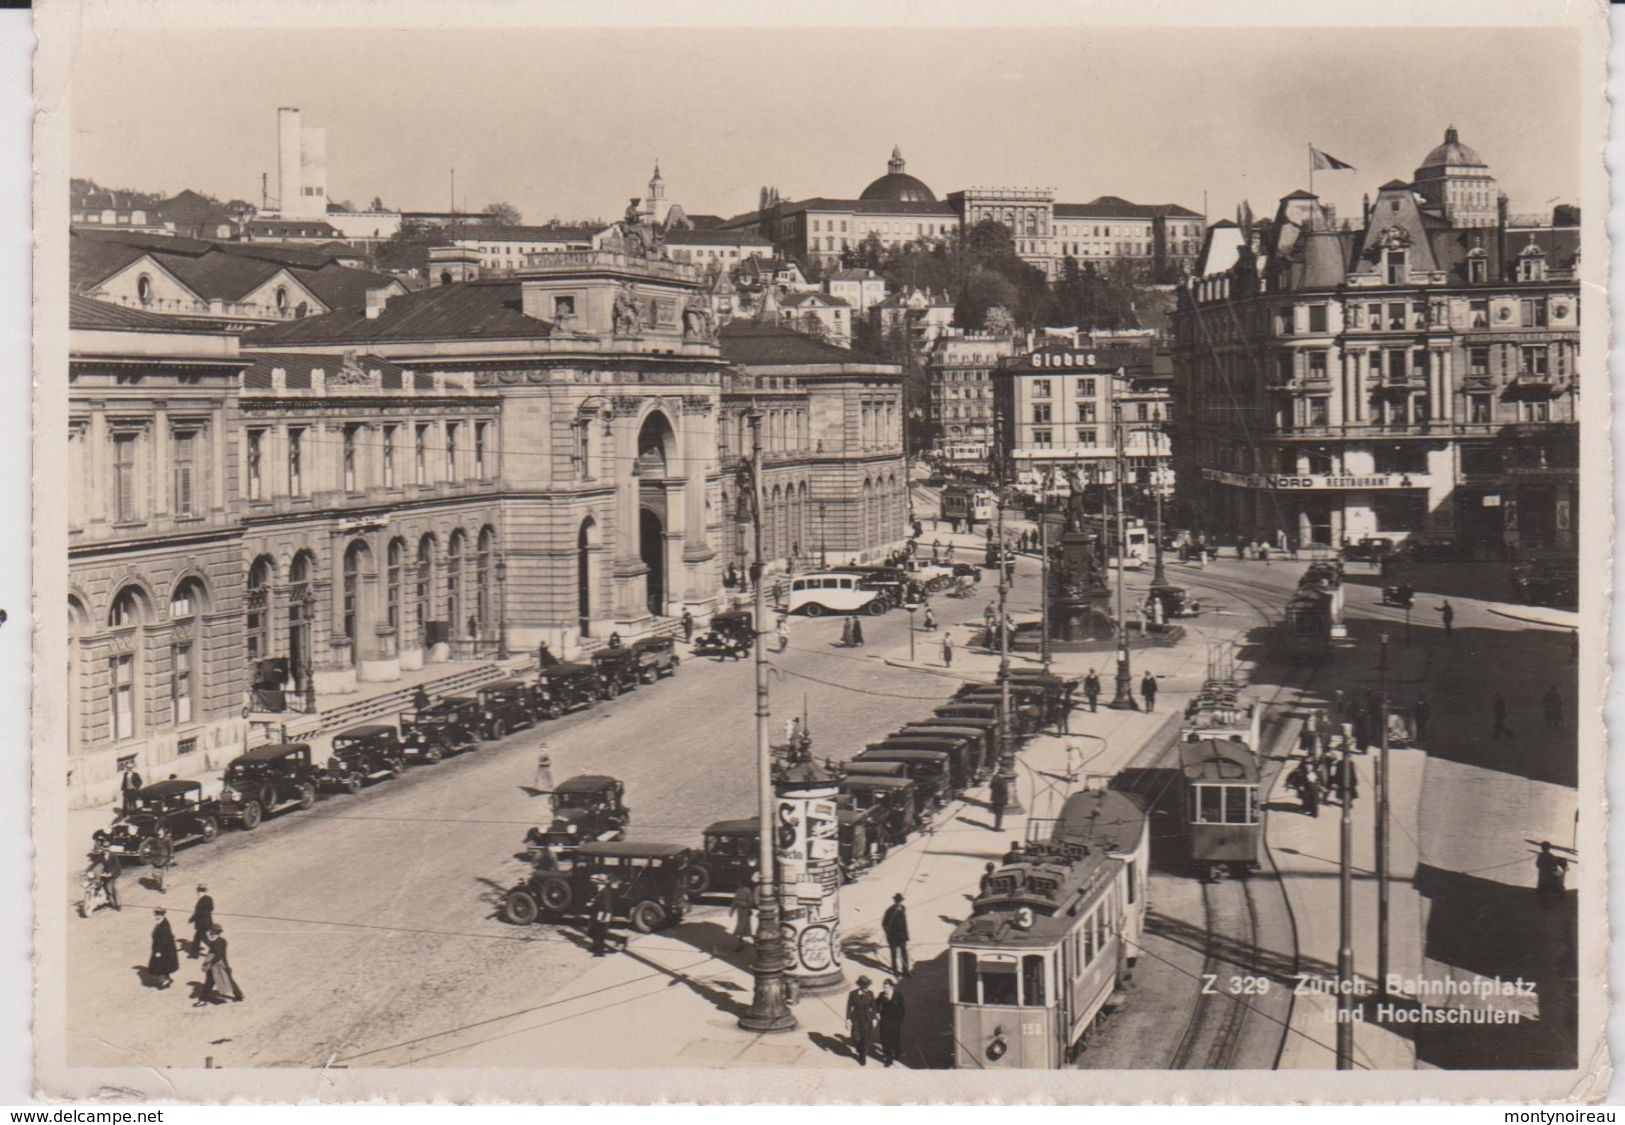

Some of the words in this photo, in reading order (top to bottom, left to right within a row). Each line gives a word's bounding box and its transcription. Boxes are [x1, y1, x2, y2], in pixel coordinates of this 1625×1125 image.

[1032, 352, 1096, 367] Globus
[1266, 476, 1313, 488] NORD
[1326, 477, 1390, 487] RESTAURANT
[1018, 907, 1034, 928] 3
